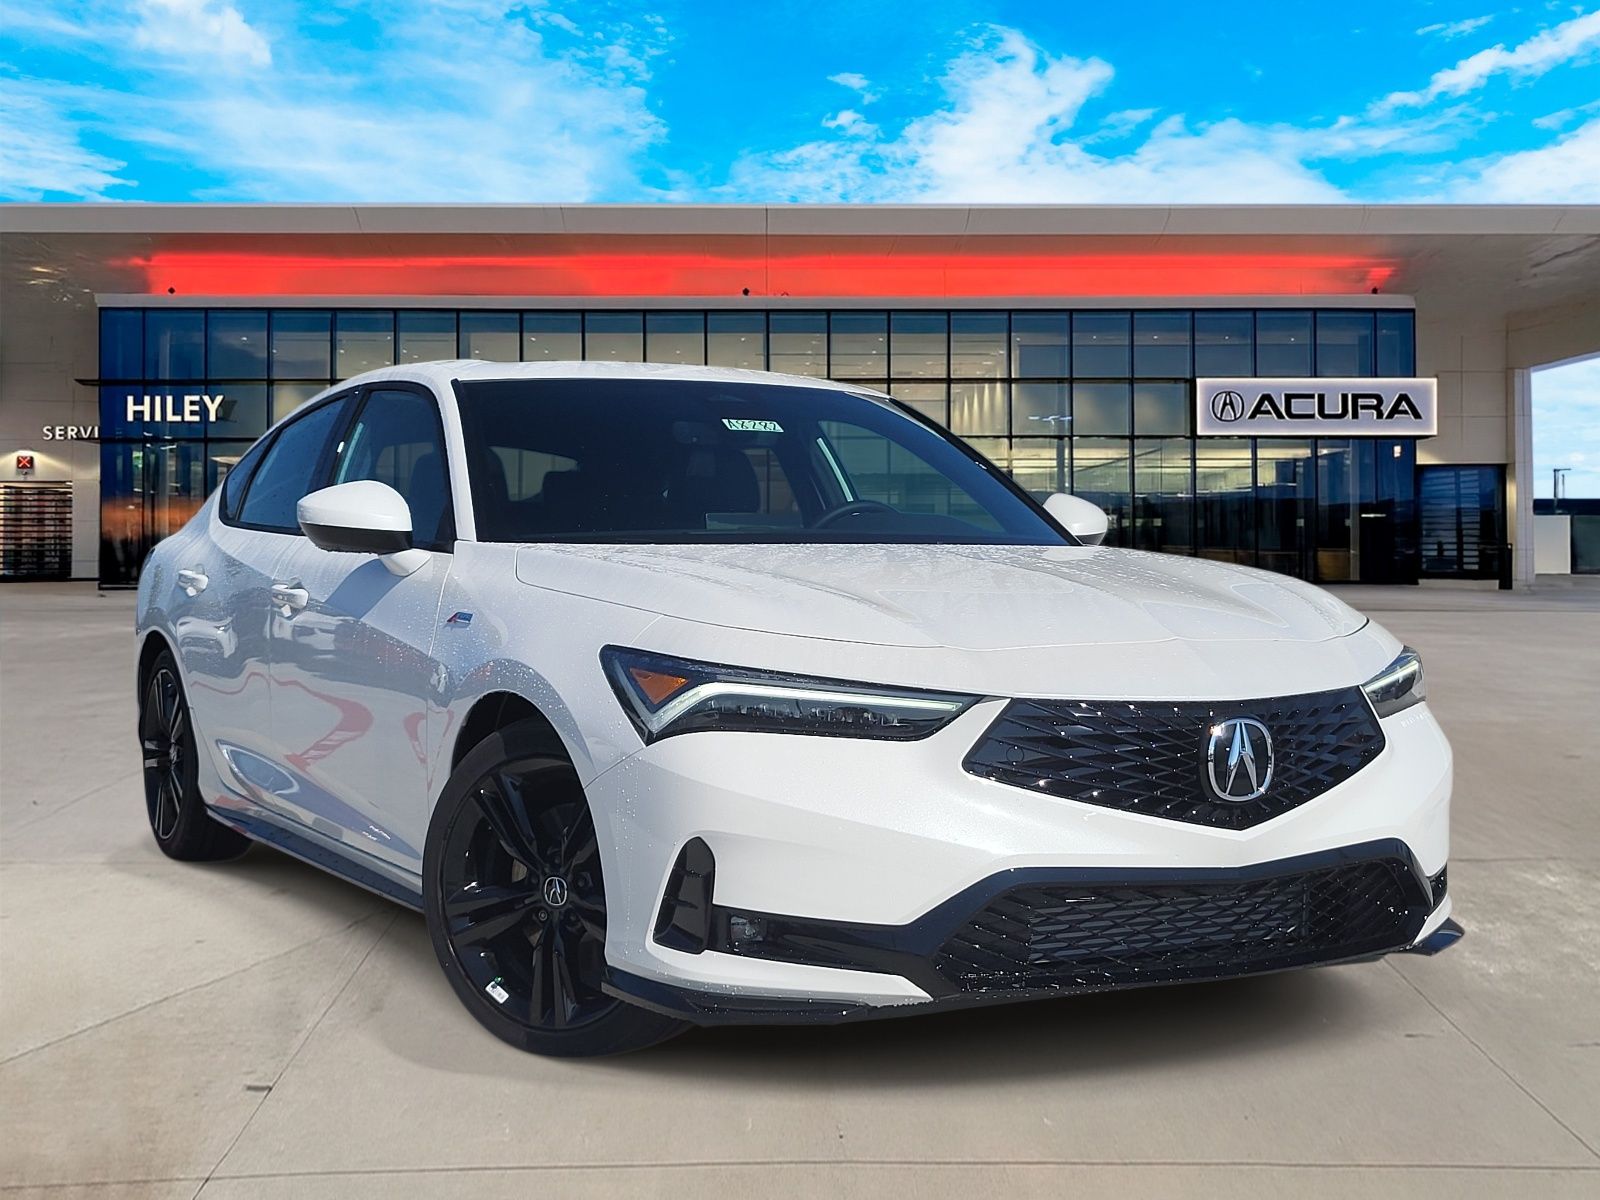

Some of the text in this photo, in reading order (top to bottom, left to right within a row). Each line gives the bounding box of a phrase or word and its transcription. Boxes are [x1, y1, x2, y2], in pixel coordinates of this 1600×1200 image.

[126, 395, 224, 422] HILEY
[1248, 393, 1422, 419] ACURA
[42, 425, 99, 440] SERVI
